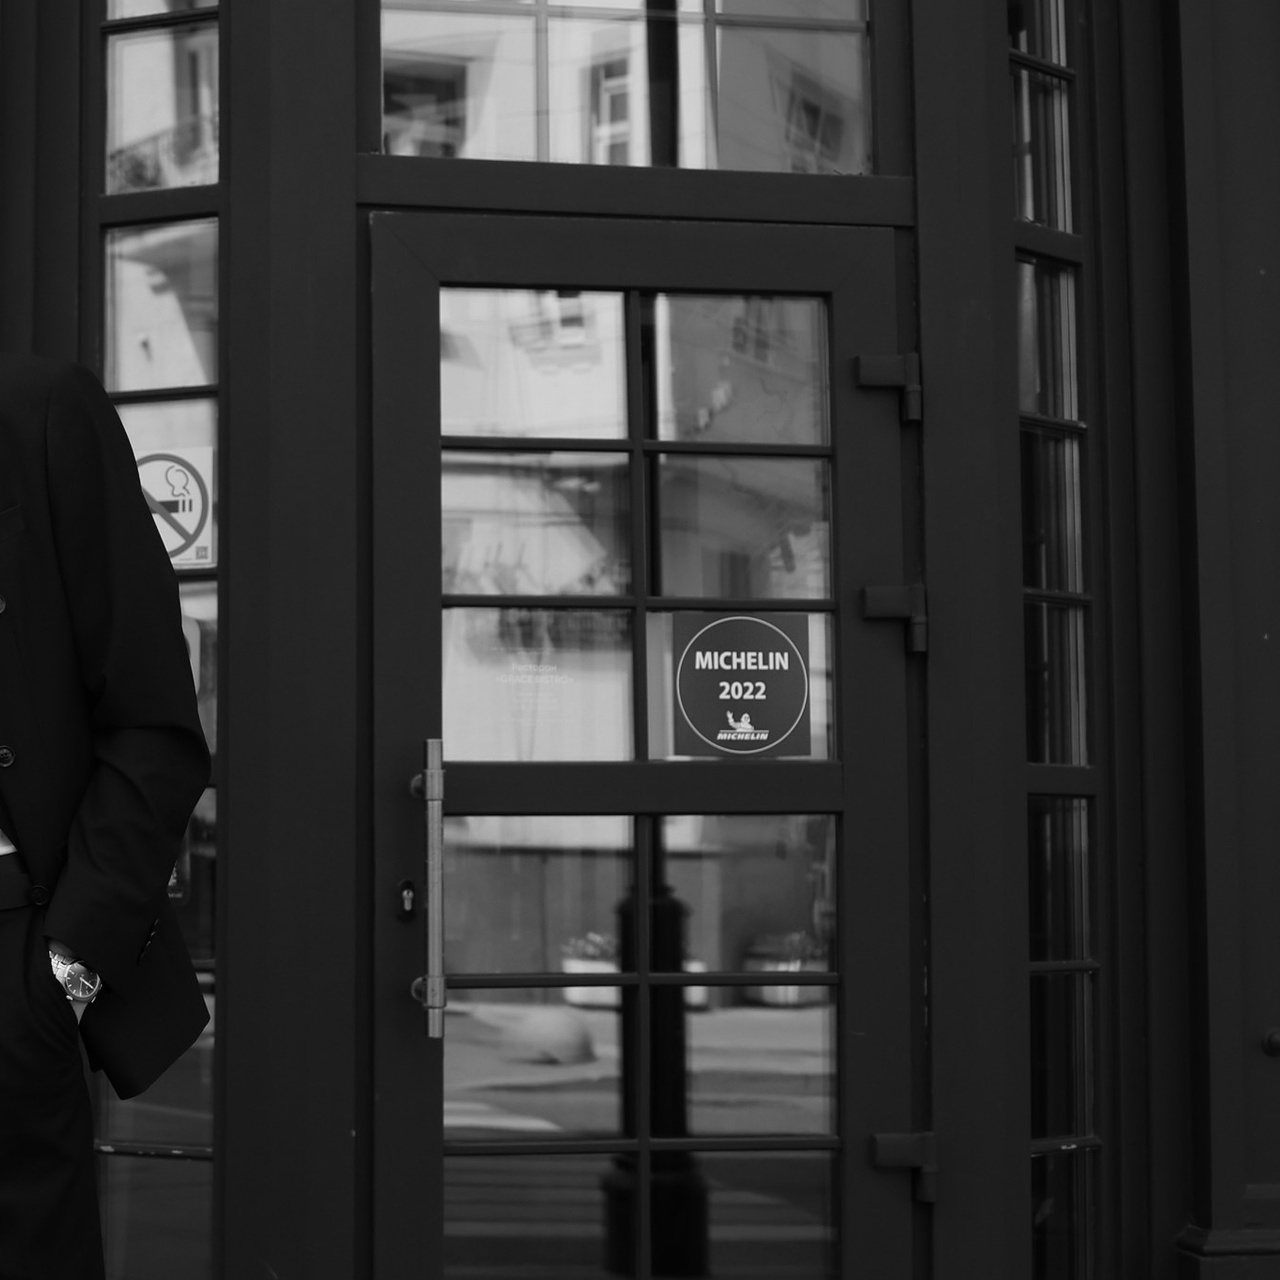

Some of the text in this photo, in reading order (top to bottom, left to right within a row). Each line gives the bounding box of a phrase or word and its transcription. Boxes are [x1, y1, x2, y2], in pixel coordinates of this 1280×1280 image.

[694, 651, 789, 671] MICHELIN
[718, 681, 767, 700] 2022
[716, 732, 769, 741] MICHELIN
